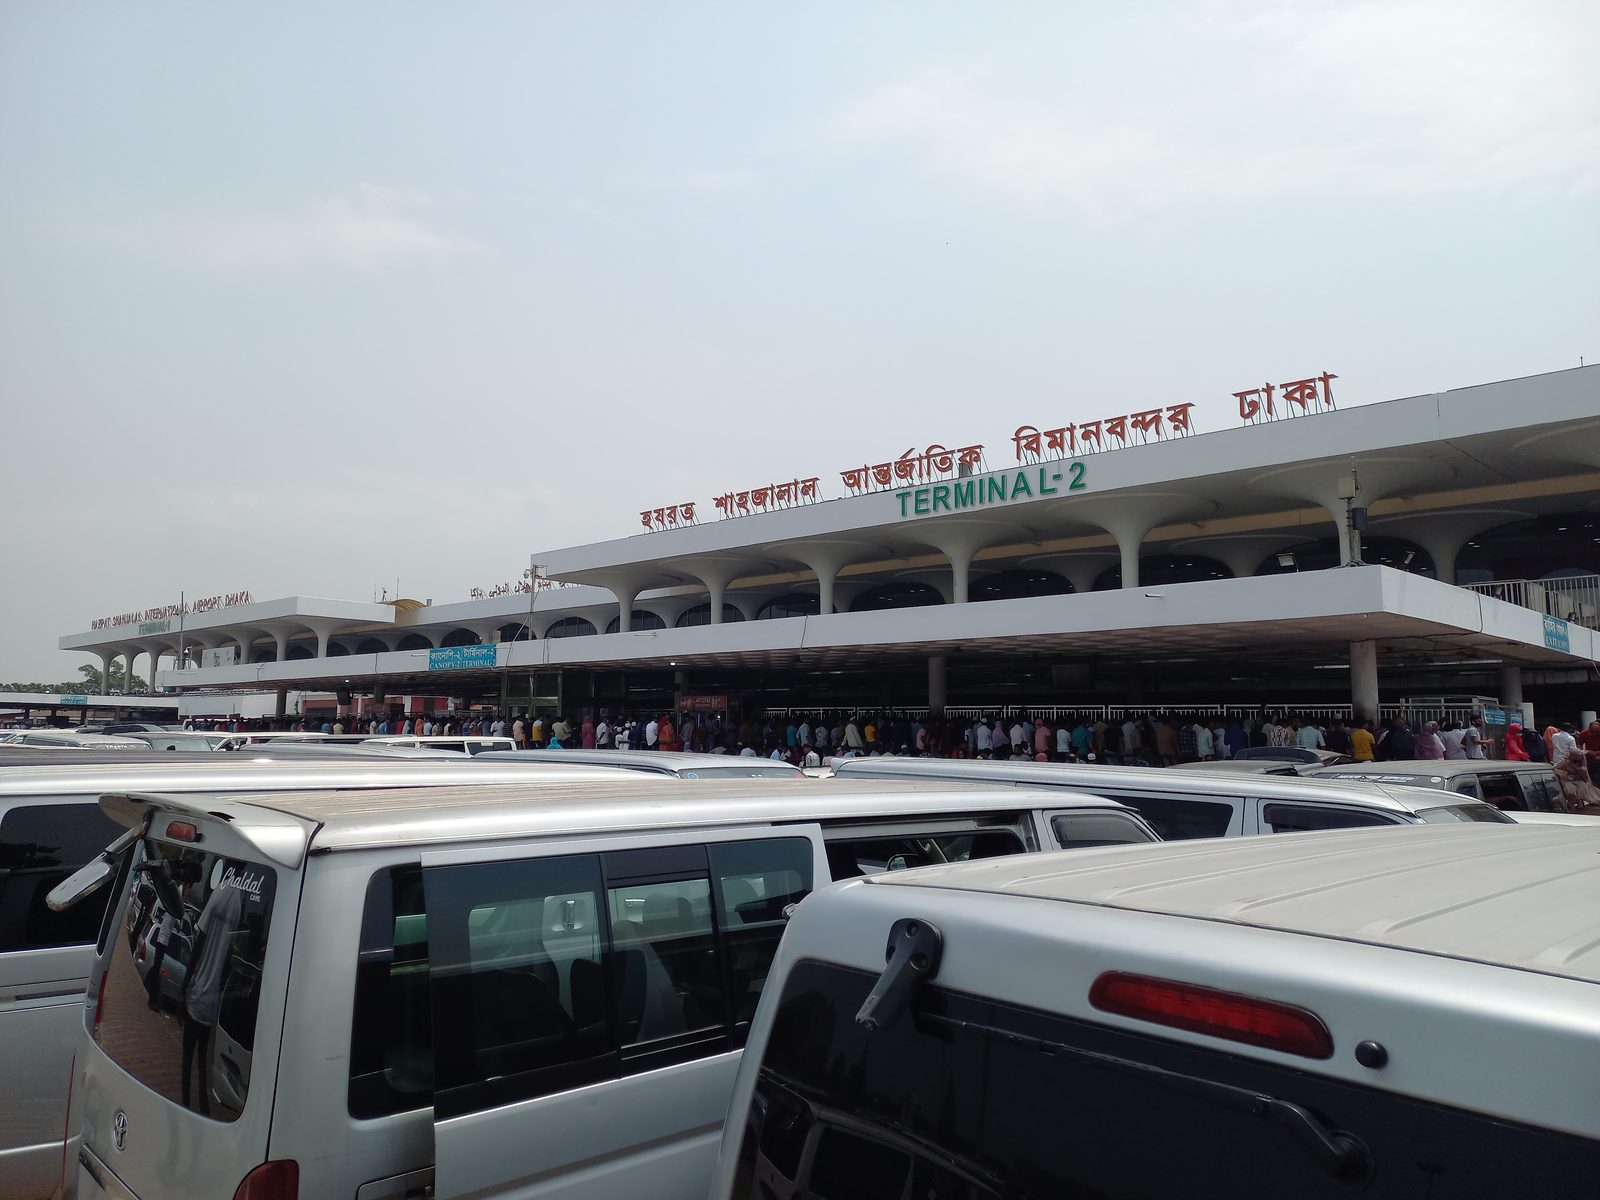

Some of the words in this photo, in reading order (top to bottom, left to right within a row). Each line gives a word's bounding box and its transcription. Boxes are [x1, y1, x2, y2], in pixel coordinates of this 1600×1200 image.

[640, 502, 696, 529] হযরত
[713, 477, 820, 515] শাহজালাল
[840, 444, 985, 490] আন্তর্জাতিক
[1012, 402, 1196, 461] বিমানবন্দর
[1232, 371, 1339, 419] ঢাকা
[225, 591, 250, 607] DHAKA
[219, 866, 265, 894] Chaldal
